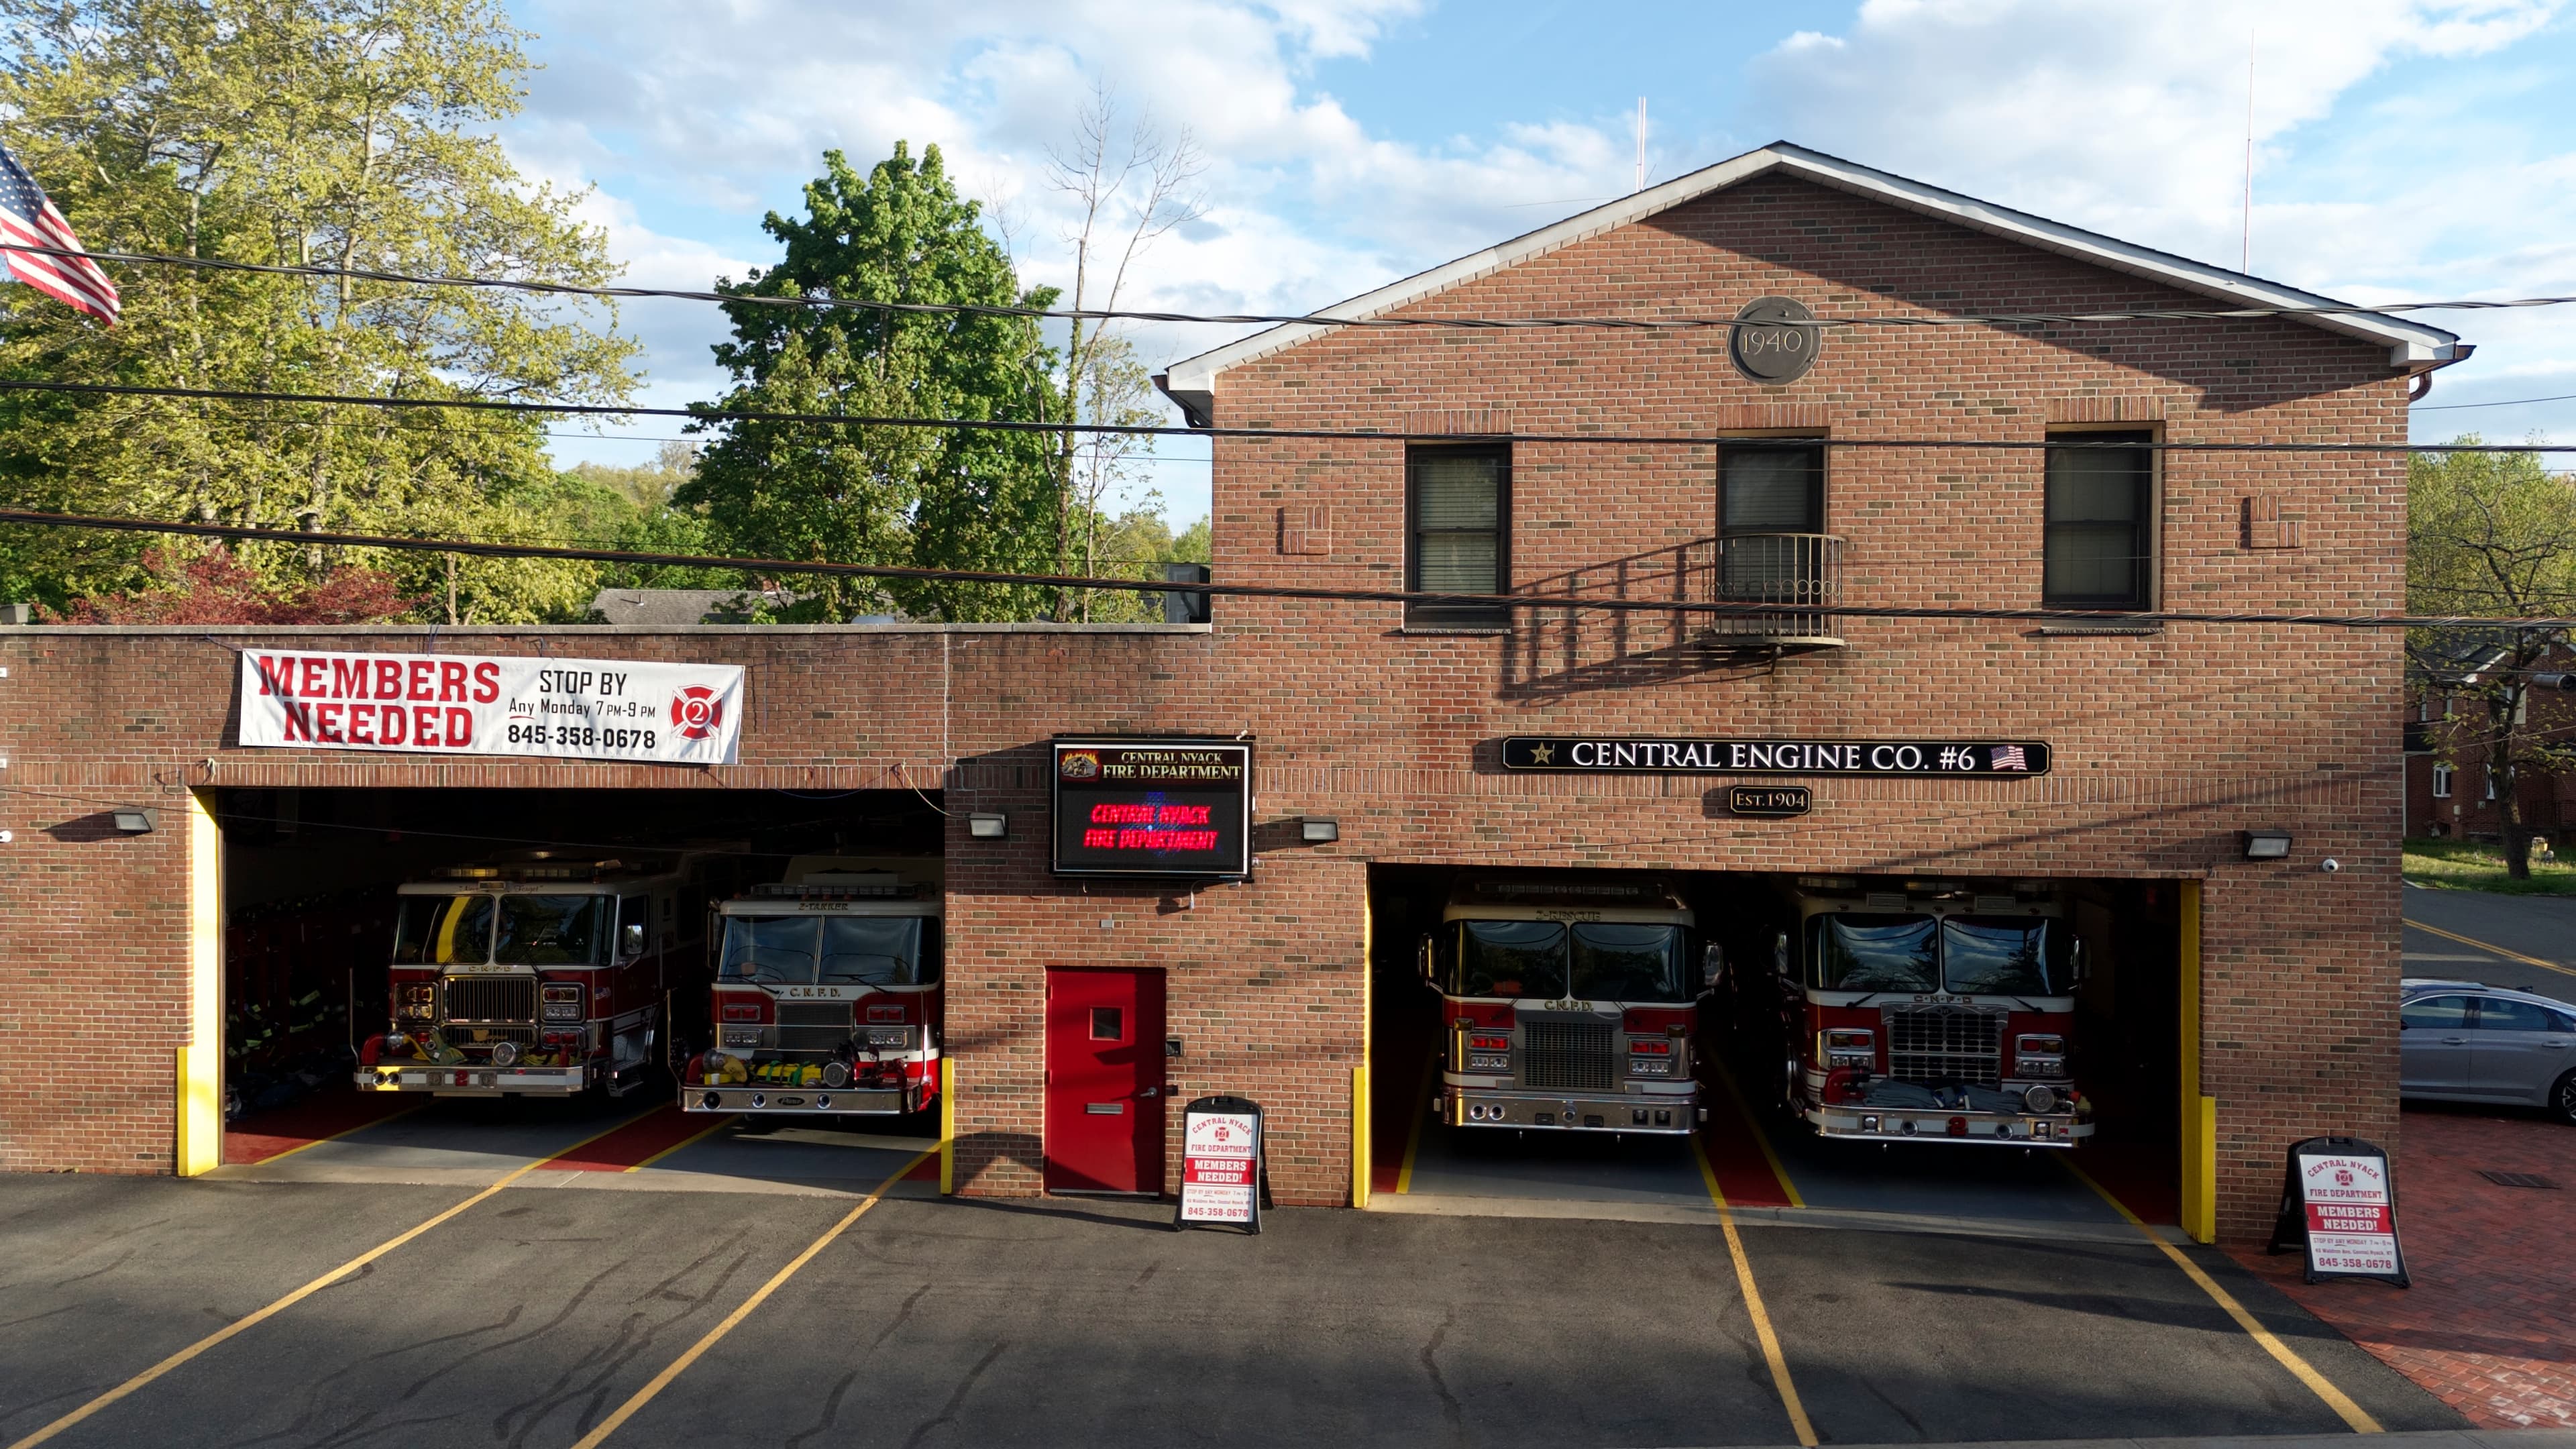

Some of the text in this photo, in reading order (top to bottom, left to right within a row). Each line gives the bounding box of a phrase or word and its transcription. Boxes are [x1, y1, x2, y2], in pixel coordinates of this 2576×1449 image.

[1743, 329, 1803, 356] 1940
[258, 655, 500, 704] MEMBERS
[539, 669, 627, 696] STOP BY
[508, 697, 535, 715] Any
[540, 698, 590, 718] Monday
[596, 700, 604, 716] 7
[641, 706, 656, 718] PM
[690, 702, 704, 722] 2
[283, 701, 473, 747] NEEDED
[508, 724, 656, 749] 845-358-0678
[1121, 751, 1223, 765] CENTRAL NYACK
[1538, 747, 1546, 758] 6
[1572, 742, 1976, 771] CENTRAL ENGINE CO. #6
[1103, 765, 1242, 780] FIRE DEPARTMENT
[1090, 804, 1212, 825] CENTRAL NYACK
[1083, 828, 1219, 851] FIRE DEPARTMENT
[455, 1069, 468, 1087] 2
[1192, 1117, 1253, 1136] CENTRAL NYACK
[1948, 1116, 1966, 1136] 2
[1191, 1144, 1252, 1153] FIRE DEPARTMENT
[1194, 1159, 1247, 1171] MEMBERS
[2307, 1159, 2379, 1179] CENTRAL NYACK
[1197, 1171, 1243, 1183] NEEDED!
[2309, 1189, 2383, 1199] FIRE DEPARTMENT
[1187, 1207, 1249, 1218] 845-358-0678
[2316, 1205, 2381, 1219] MEMBERS
[2322, 1219, 2378, 1232] NEEDED!
[2318, 1257, 2393, 1269] 845-358-0678
